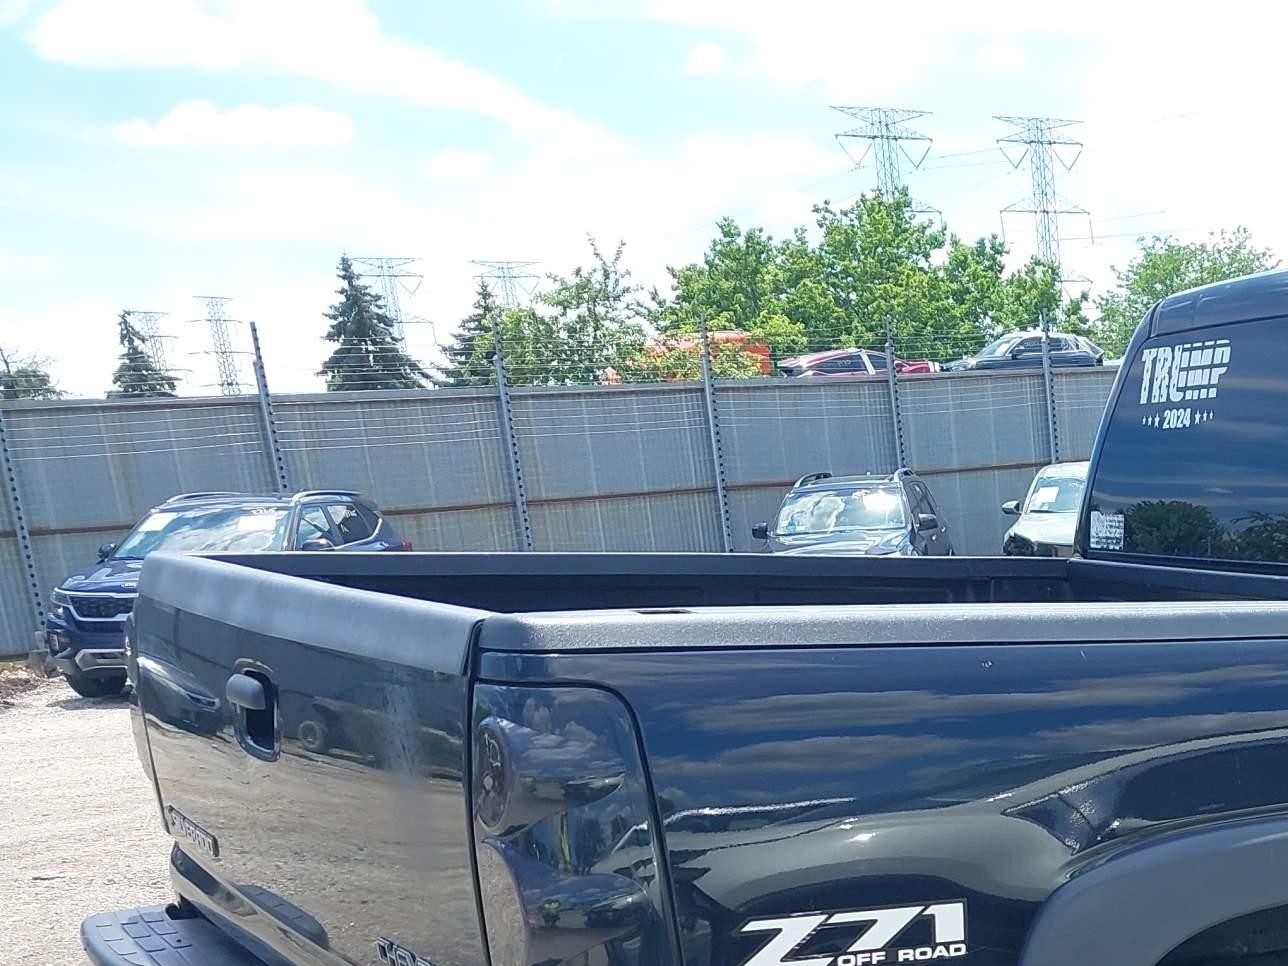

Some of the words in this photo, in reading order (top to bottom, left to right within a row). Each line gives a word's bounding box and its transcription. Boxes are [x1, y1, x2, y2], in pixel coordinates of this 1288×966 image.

[1140, 340, 1231, 405] TRUMP
[1162, 408, 1191, 429] 2024
[898, 943, 967, 961] ROAD
